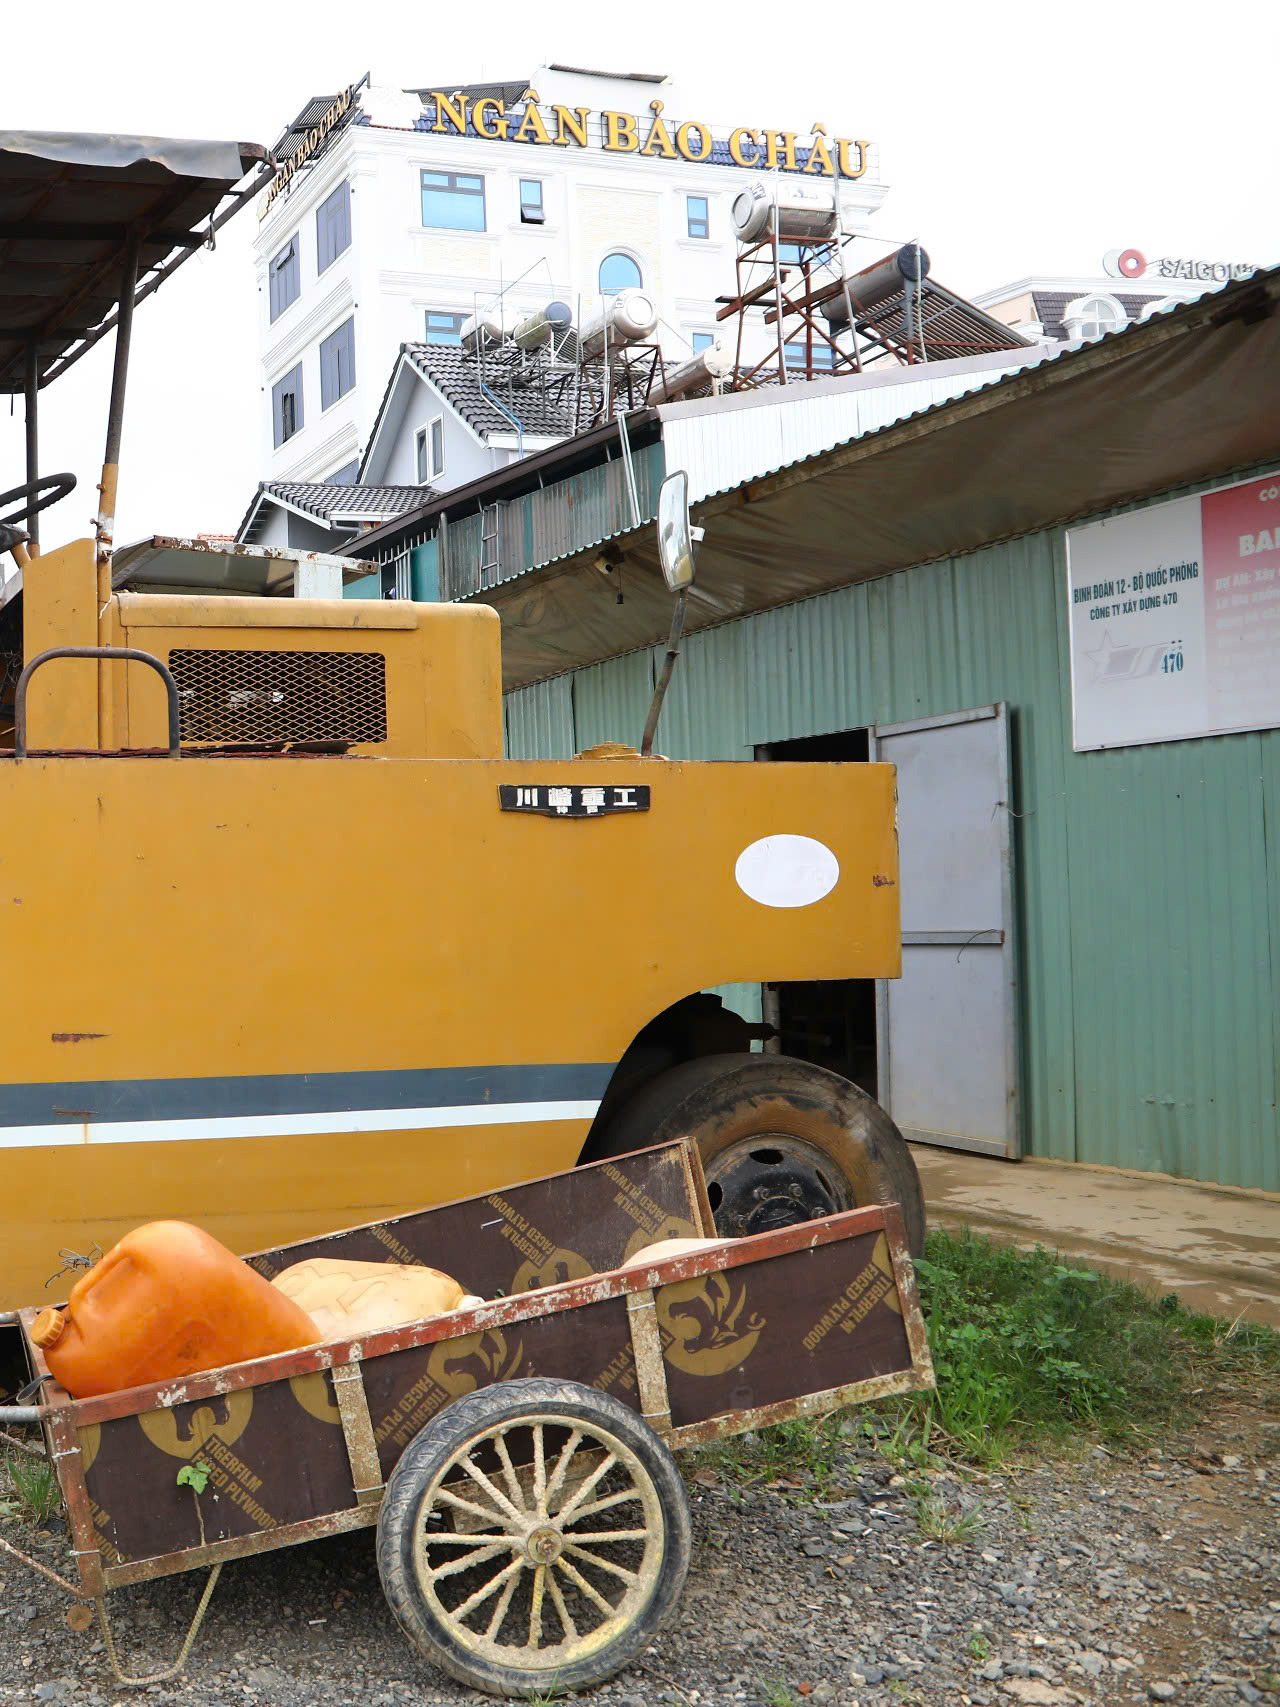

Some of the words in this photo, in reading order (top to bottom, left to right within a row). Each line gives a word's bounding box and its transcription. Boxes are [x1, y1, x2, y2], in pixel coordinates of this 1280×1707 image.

[431, 90, 591, 148] NGÂN
[602, 100, 712, 161] BẢO
[729, 123, 870, 179] CHÂU
[1074, 586, 1092, 604] BINH
[1093, 580, 1115, 600] ĐOÀN
[1116, 579, 1126, 595] 12
[1133, 571, 1144, 594] BỘ
[1145, 565, 1168, 590] QUỐC
[1170, 561, 1199, 583] PHÒNG
[1090, 605, 1111, 621] CÔNG
[1112, 604, 1121, 616] TY
[1122, 600, 1138, 615] XÂY
[1140, 595, 1161, 613] DỰNG
[1163, 592, 1178, 606] 470
[1161, 652, 1184, 673] 470
[487, 1194, 530, 1229] PLYWOOD
[613, 1192, 659, 1236] TIGERFILM
[638, 1194, 669, 1223] FACED
[500, 1223, 547, 1267] TIGERFILM
[526, 1225, 557, 1255] FACED
[845, 1262, 881, 1302] FACED
[801, 1295, 850, 1352] PLYWOOD
[839, 1275, 894, 1336] TIGERFILM
[399, 1374, 435, 1413] FACED
[373, 1408, 405, 1445] PLYW
[392, 1387, 449, 1448] TIGERFILM
[205, 1436, 263, 1493] TIGERFILM
[223, 1481, 277, 1529] PLYWOOD
